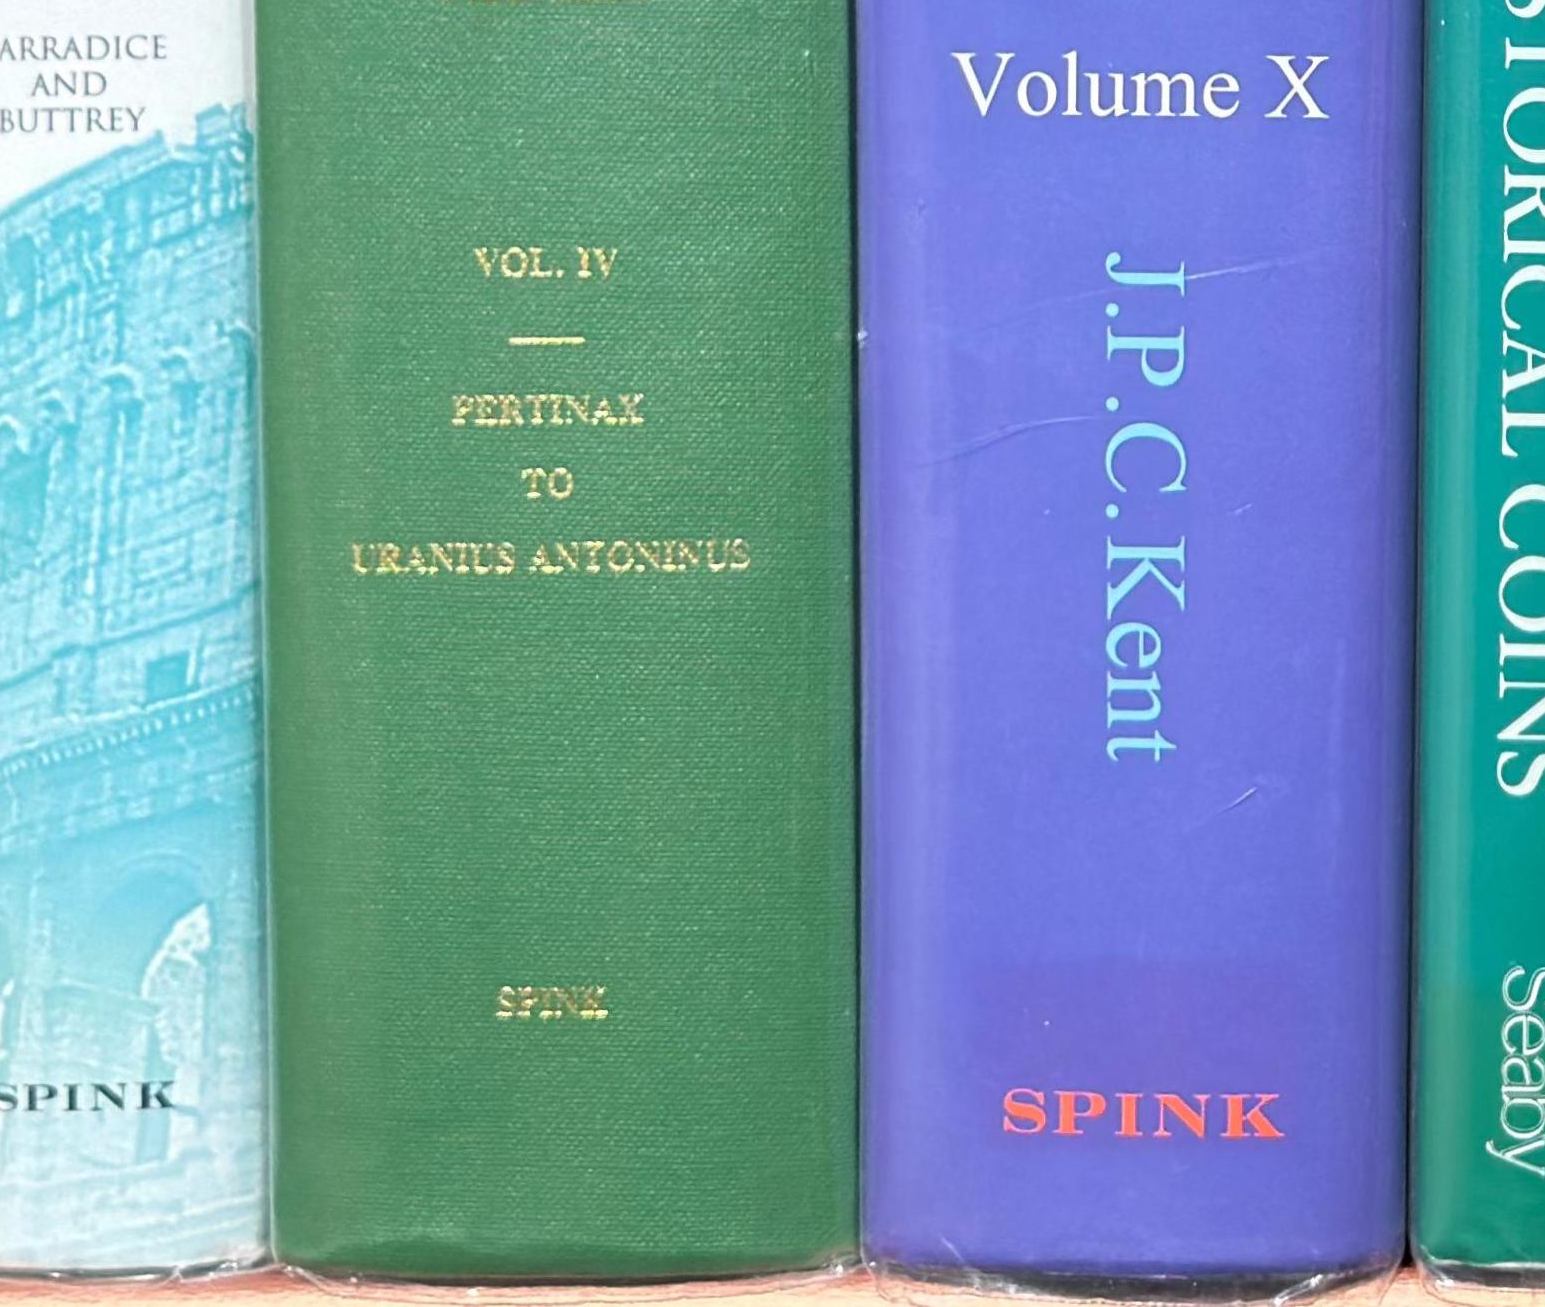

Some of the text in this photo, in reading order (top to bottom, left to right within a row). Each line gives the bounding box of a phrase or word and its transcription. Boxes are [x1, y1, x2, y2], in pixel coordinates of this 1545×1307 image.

[29, 71, 108, 98] AND
[950, 48, 1331, 121] Volume X
[473, 246, 619, 279] VOL. IV
[450, 392, 646, 428] PERTINAX
[520, 466, 575, 500] TO
[351, 537, 752, 576] URANIUS ANTONINUS
[495, 985, 609, 1021] SPINK
[1002, 1087, 1287, 1141] SPINK
